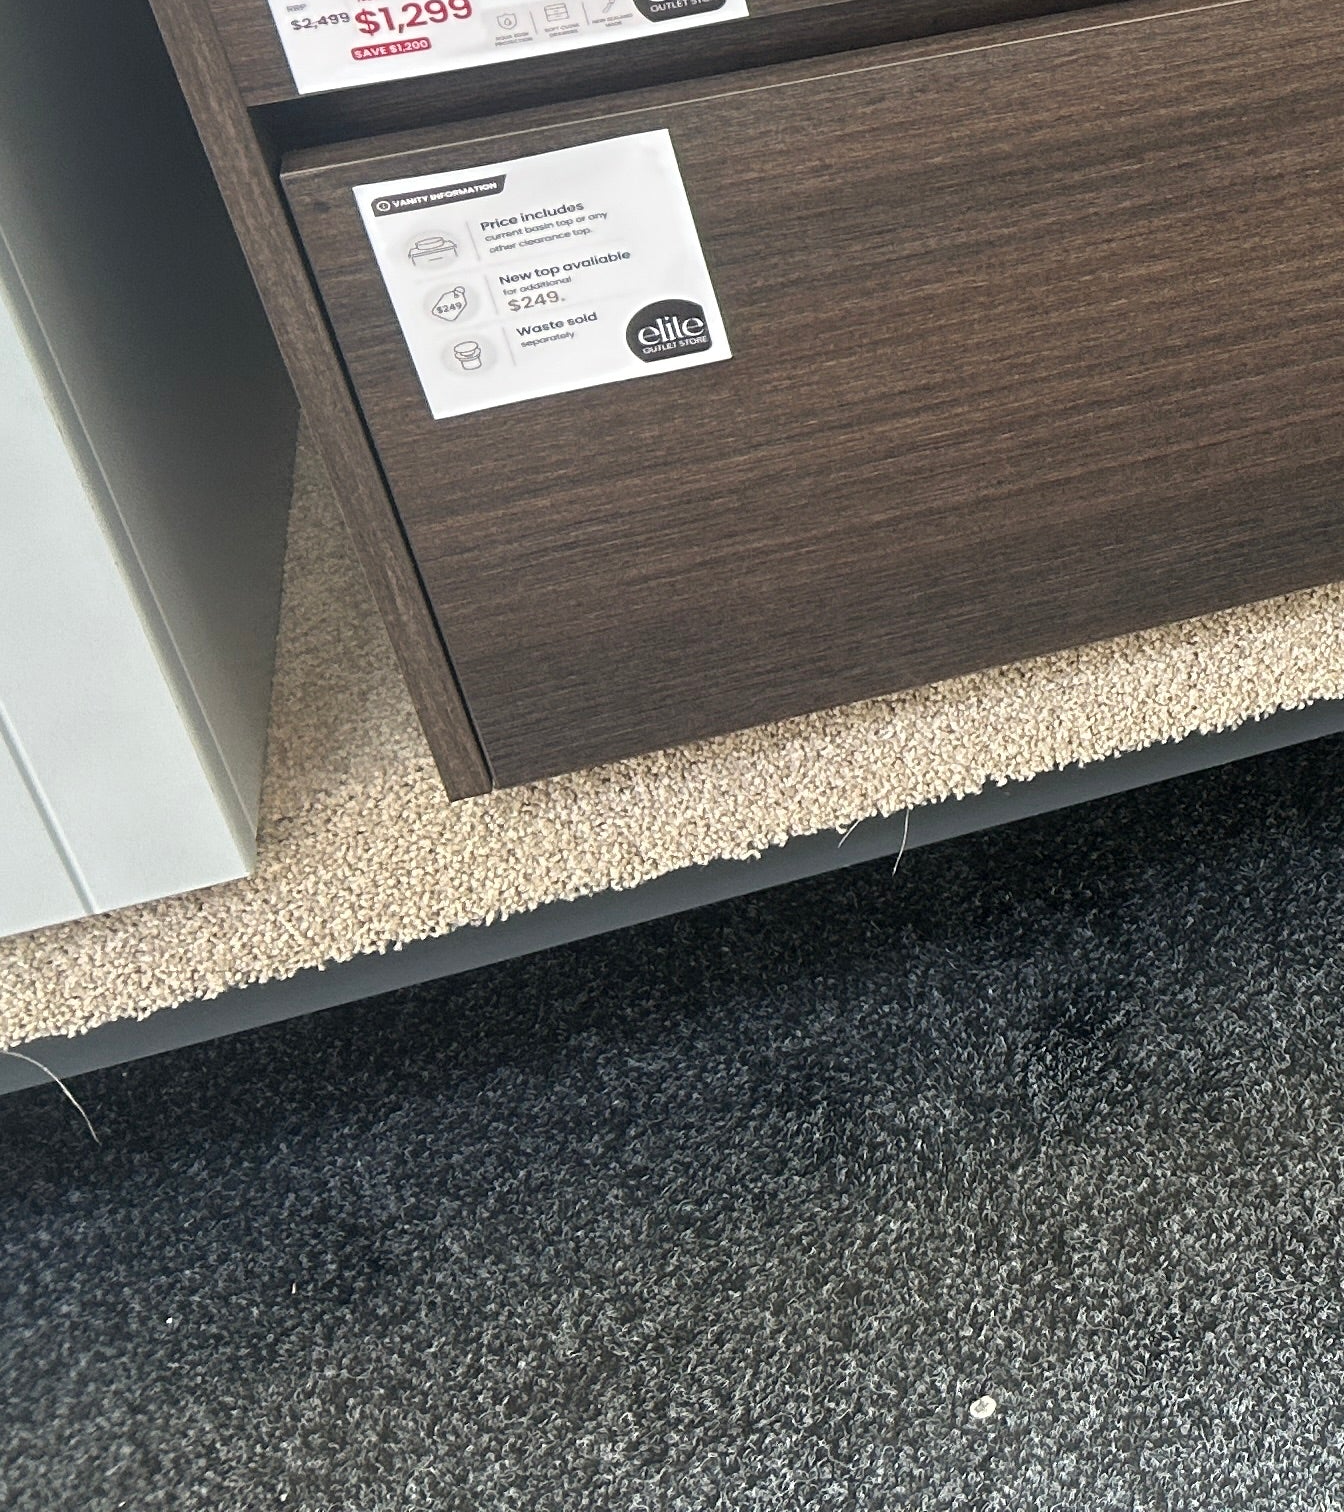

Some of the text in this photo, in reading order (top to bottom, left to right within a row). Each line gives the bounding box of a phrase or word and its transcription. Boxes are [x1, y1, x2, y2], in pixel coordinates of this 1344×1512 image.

[650, 0, 689, 14] OUTLET
[290, 12, 351, 31] $2,499
[353, 39, 429, 60] SAVE $1,200
[391, 182, 498, 208] VANITY INFORMATION
[480, 201, 585, 231] Price includes
[485, 228, 526, 242] current
[556, 217, 574, 228] top
[588, 212, 608, 222] any
[489, 242, 517, 254] other
[518, 232, 572, 248] clearance
[499, 271, 532, 285] New
[534, 265, 560, 277] top
[502, 276, 572, 296] for additional
[436, 301, 463, 314] $249
[508, 290, 566, 313] $249.
[516, 311, 598, 337] Waste sold
[638, 316, 705, 346] elite
[520, 331, 575, 348] separately
[642, 335, 708, 355] OUTLET STORE
